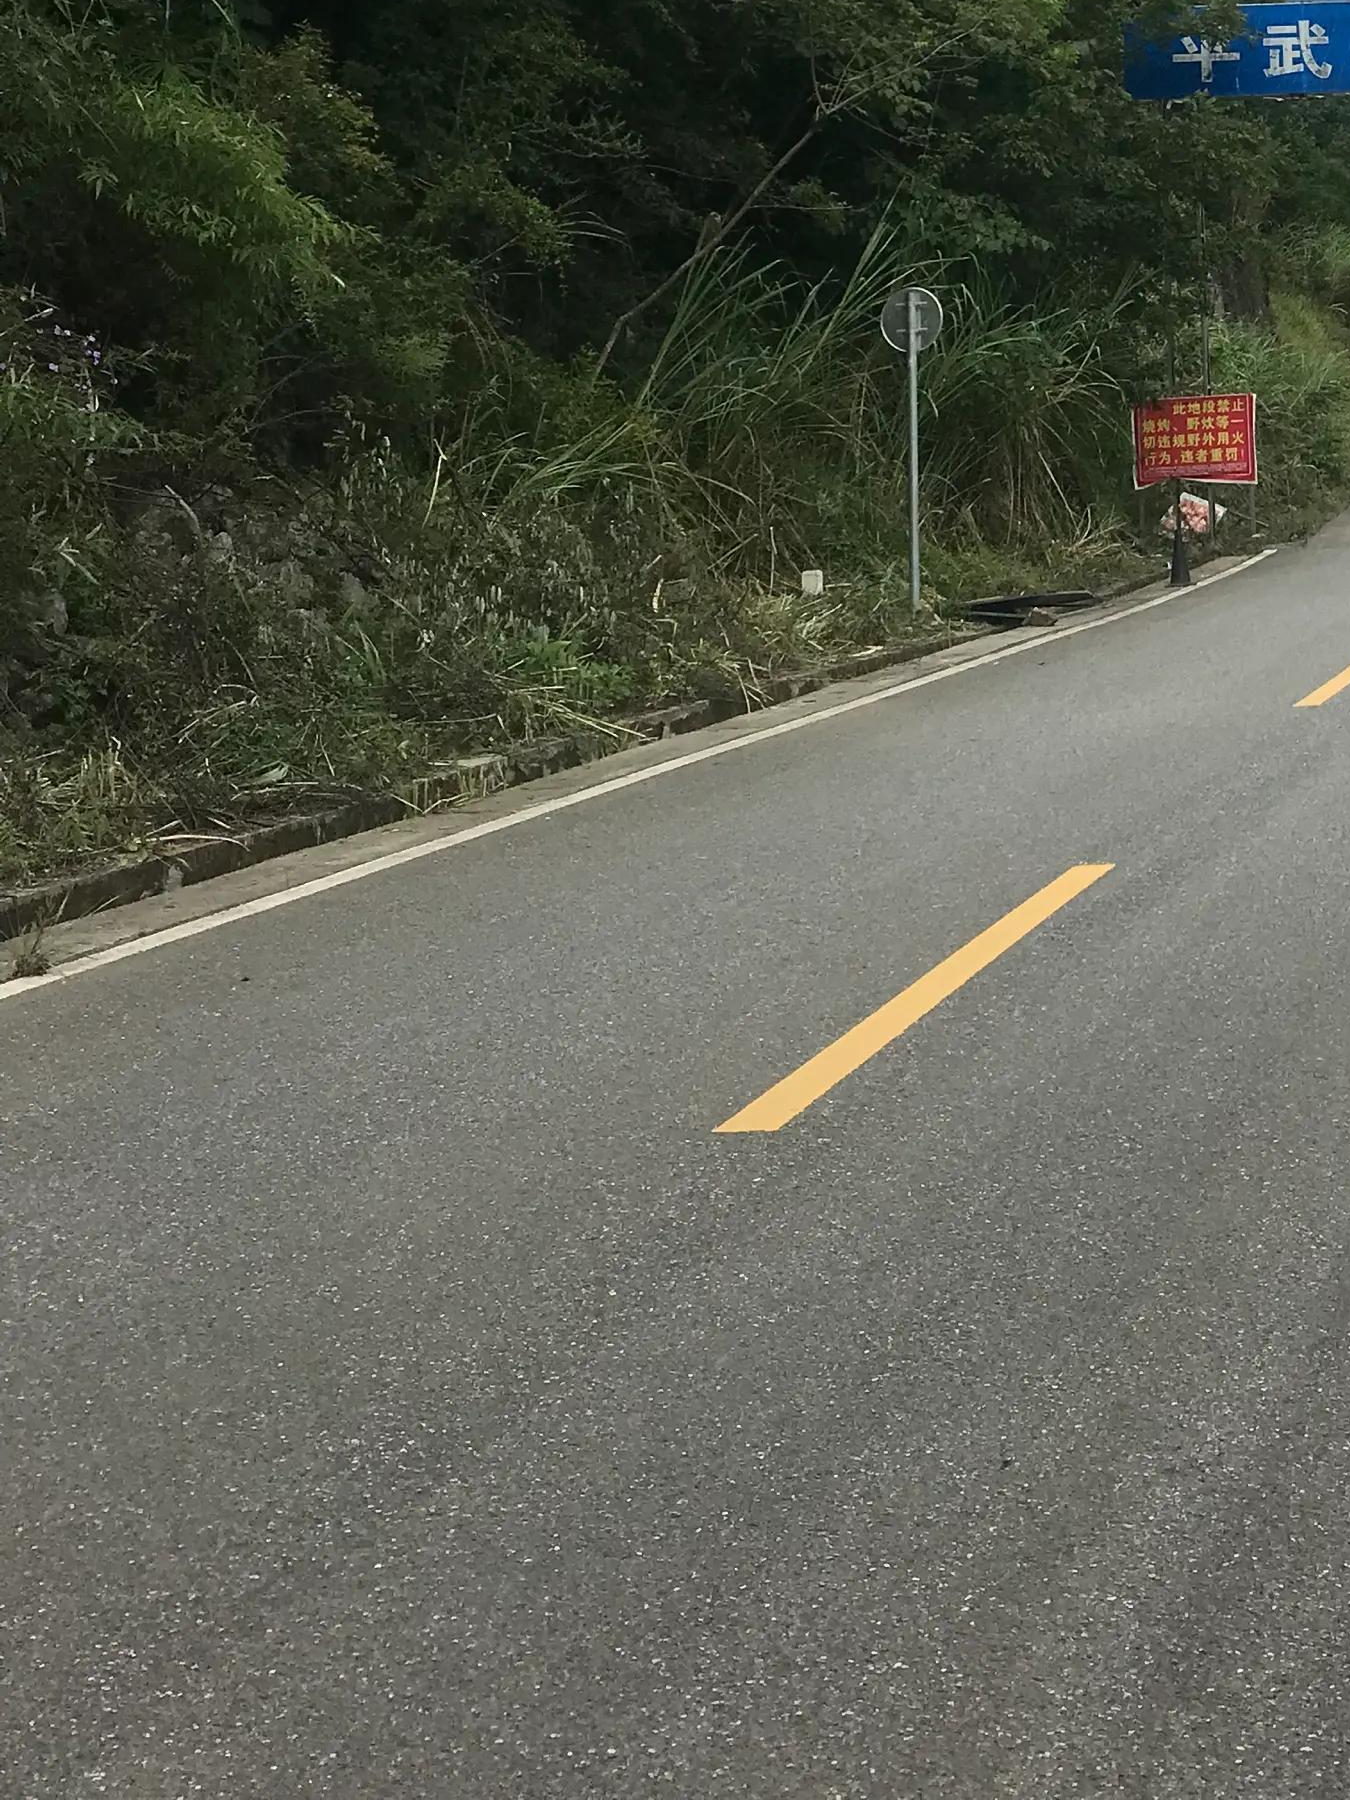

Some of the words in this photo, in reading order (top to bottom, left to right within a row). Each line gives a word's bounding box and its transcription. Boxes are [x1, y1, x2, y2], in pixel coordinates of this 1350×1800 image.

[1173, 398, 1245, 415] 此地段禁止
[1143, 432, 1245, 449] 切违规野外用火
